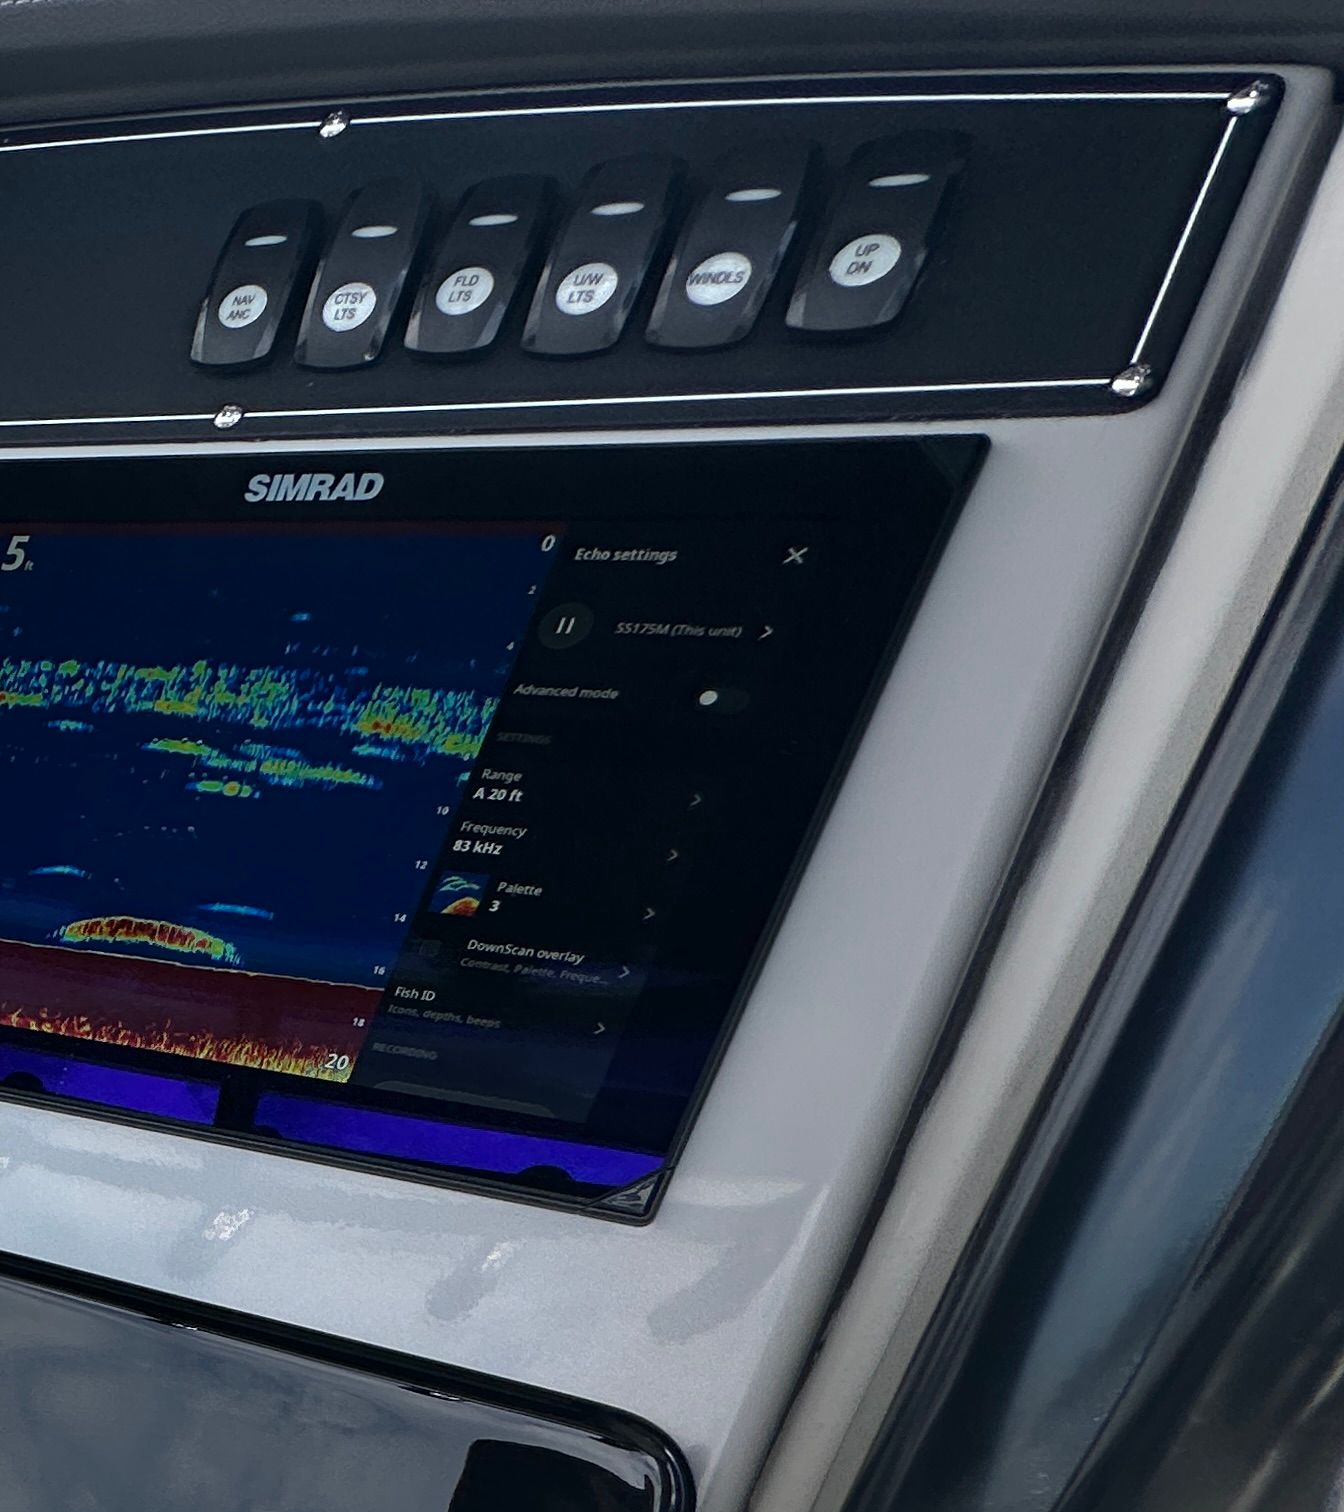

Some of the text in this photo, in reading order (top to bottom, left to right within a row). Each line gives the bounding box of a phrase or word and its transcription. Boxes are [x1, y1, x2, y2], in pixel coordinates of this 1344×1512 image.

[855, 244, 879, 257] UP
[846, 261, 871, 274] DN
[453, 274, 480, 287] FLD
[574, 273, 605, 285] U/W
[688, 270, 746, 286] WINDLS
[232, 295, 256, 306] NAV
[334, 292, 368, 306] CTSY
[448, 291, 472, 303] LTS
[566, 290, 596, 303] LTS
[226, 309, 251, 320] ANC
[334, 308, 356, 320] LTS
[244, 472, 384, 502] SIMRAD
[541, 534, 556, 551] 0
[574, 548, 678, 565] Echo settings
[528, 585, 537, 595] 2
[671, 623, 705, 637] (This
[708, 626, 743, 638] unit)
[513, 684, 620, 700] Advanced mode
[482, 768, 522, 784] Range
[473, 788, 524, 802] A 20 ft
[436, 806, 449, 816] 10
[460, 821, 527, 839] Frequency
[453, 840, 503, 855] 83 kHz
[415, 860, 428, 870] 12
[496, 882, 543, 897] Palette
[489, 901, 501, 912] 3
[394, 913, 407, 923] 14
[467, 939, 585, 965] DownScan overlay
[374, 965, 386, 976] 16
[395, 986, 436, 1001] Fish ID
[352, 1017, 365, 1028] 18
[324, 1053, 349, 1070] 20
